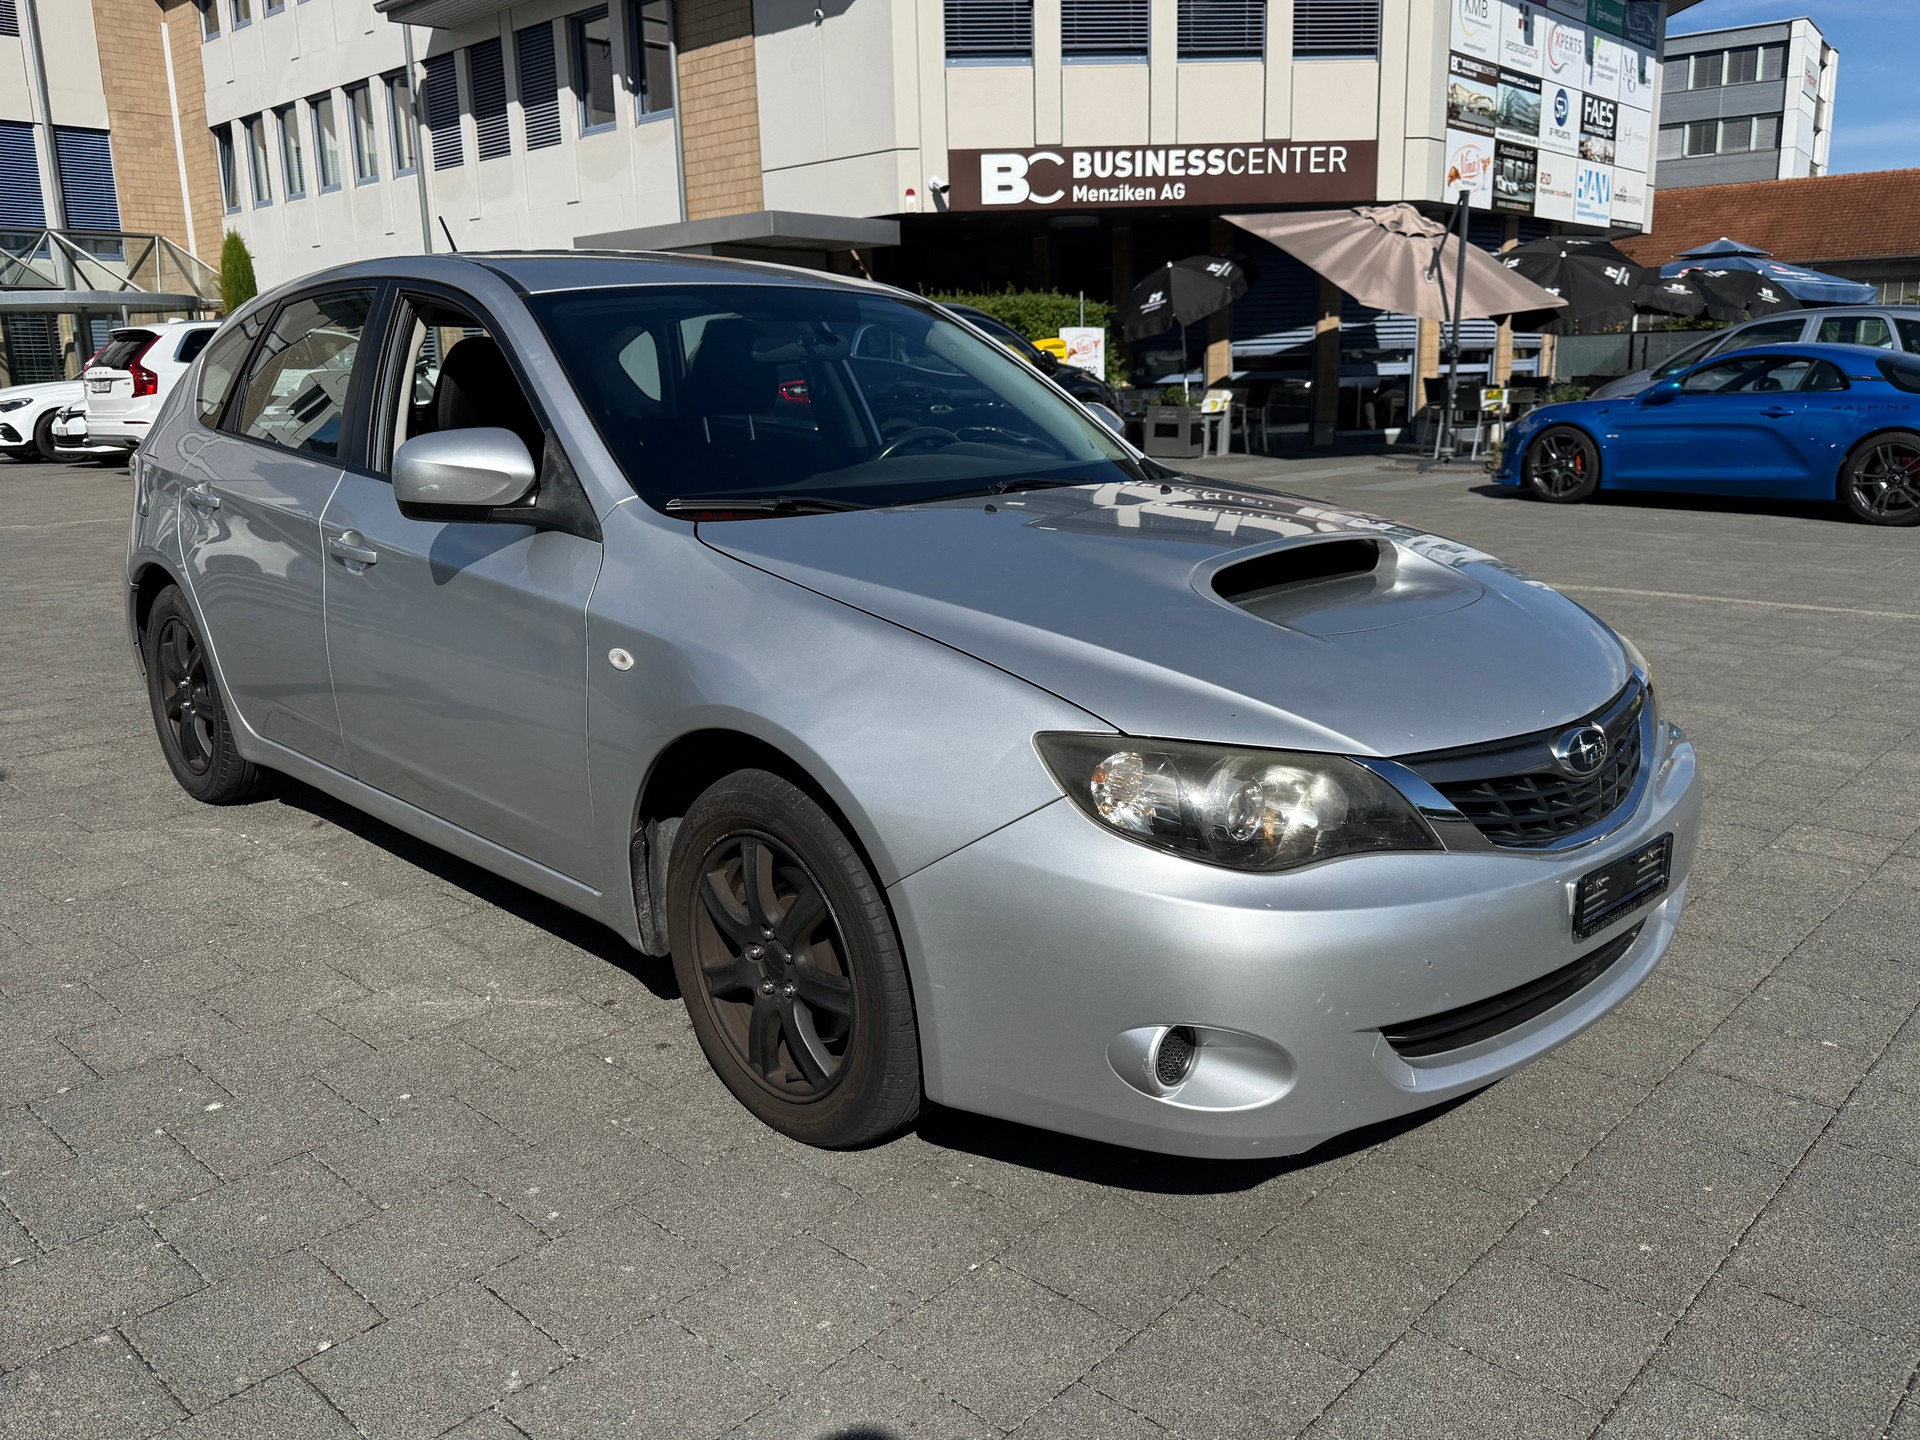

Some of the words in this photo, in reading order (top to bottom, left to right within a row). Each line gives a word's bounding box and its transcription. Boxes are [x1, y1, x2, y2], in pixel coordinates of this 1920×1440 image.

[1554, 31, 1583, 55] XPERTS
[1583, 96, 1615, 128] FAES
[980, 151, 1065, 206] BC
[1072, 146, 1348, 179] BUSINESSCENTER
[1072, 184, 1156, 203] Menziken
[1160, 182, 1186, 201] AG
